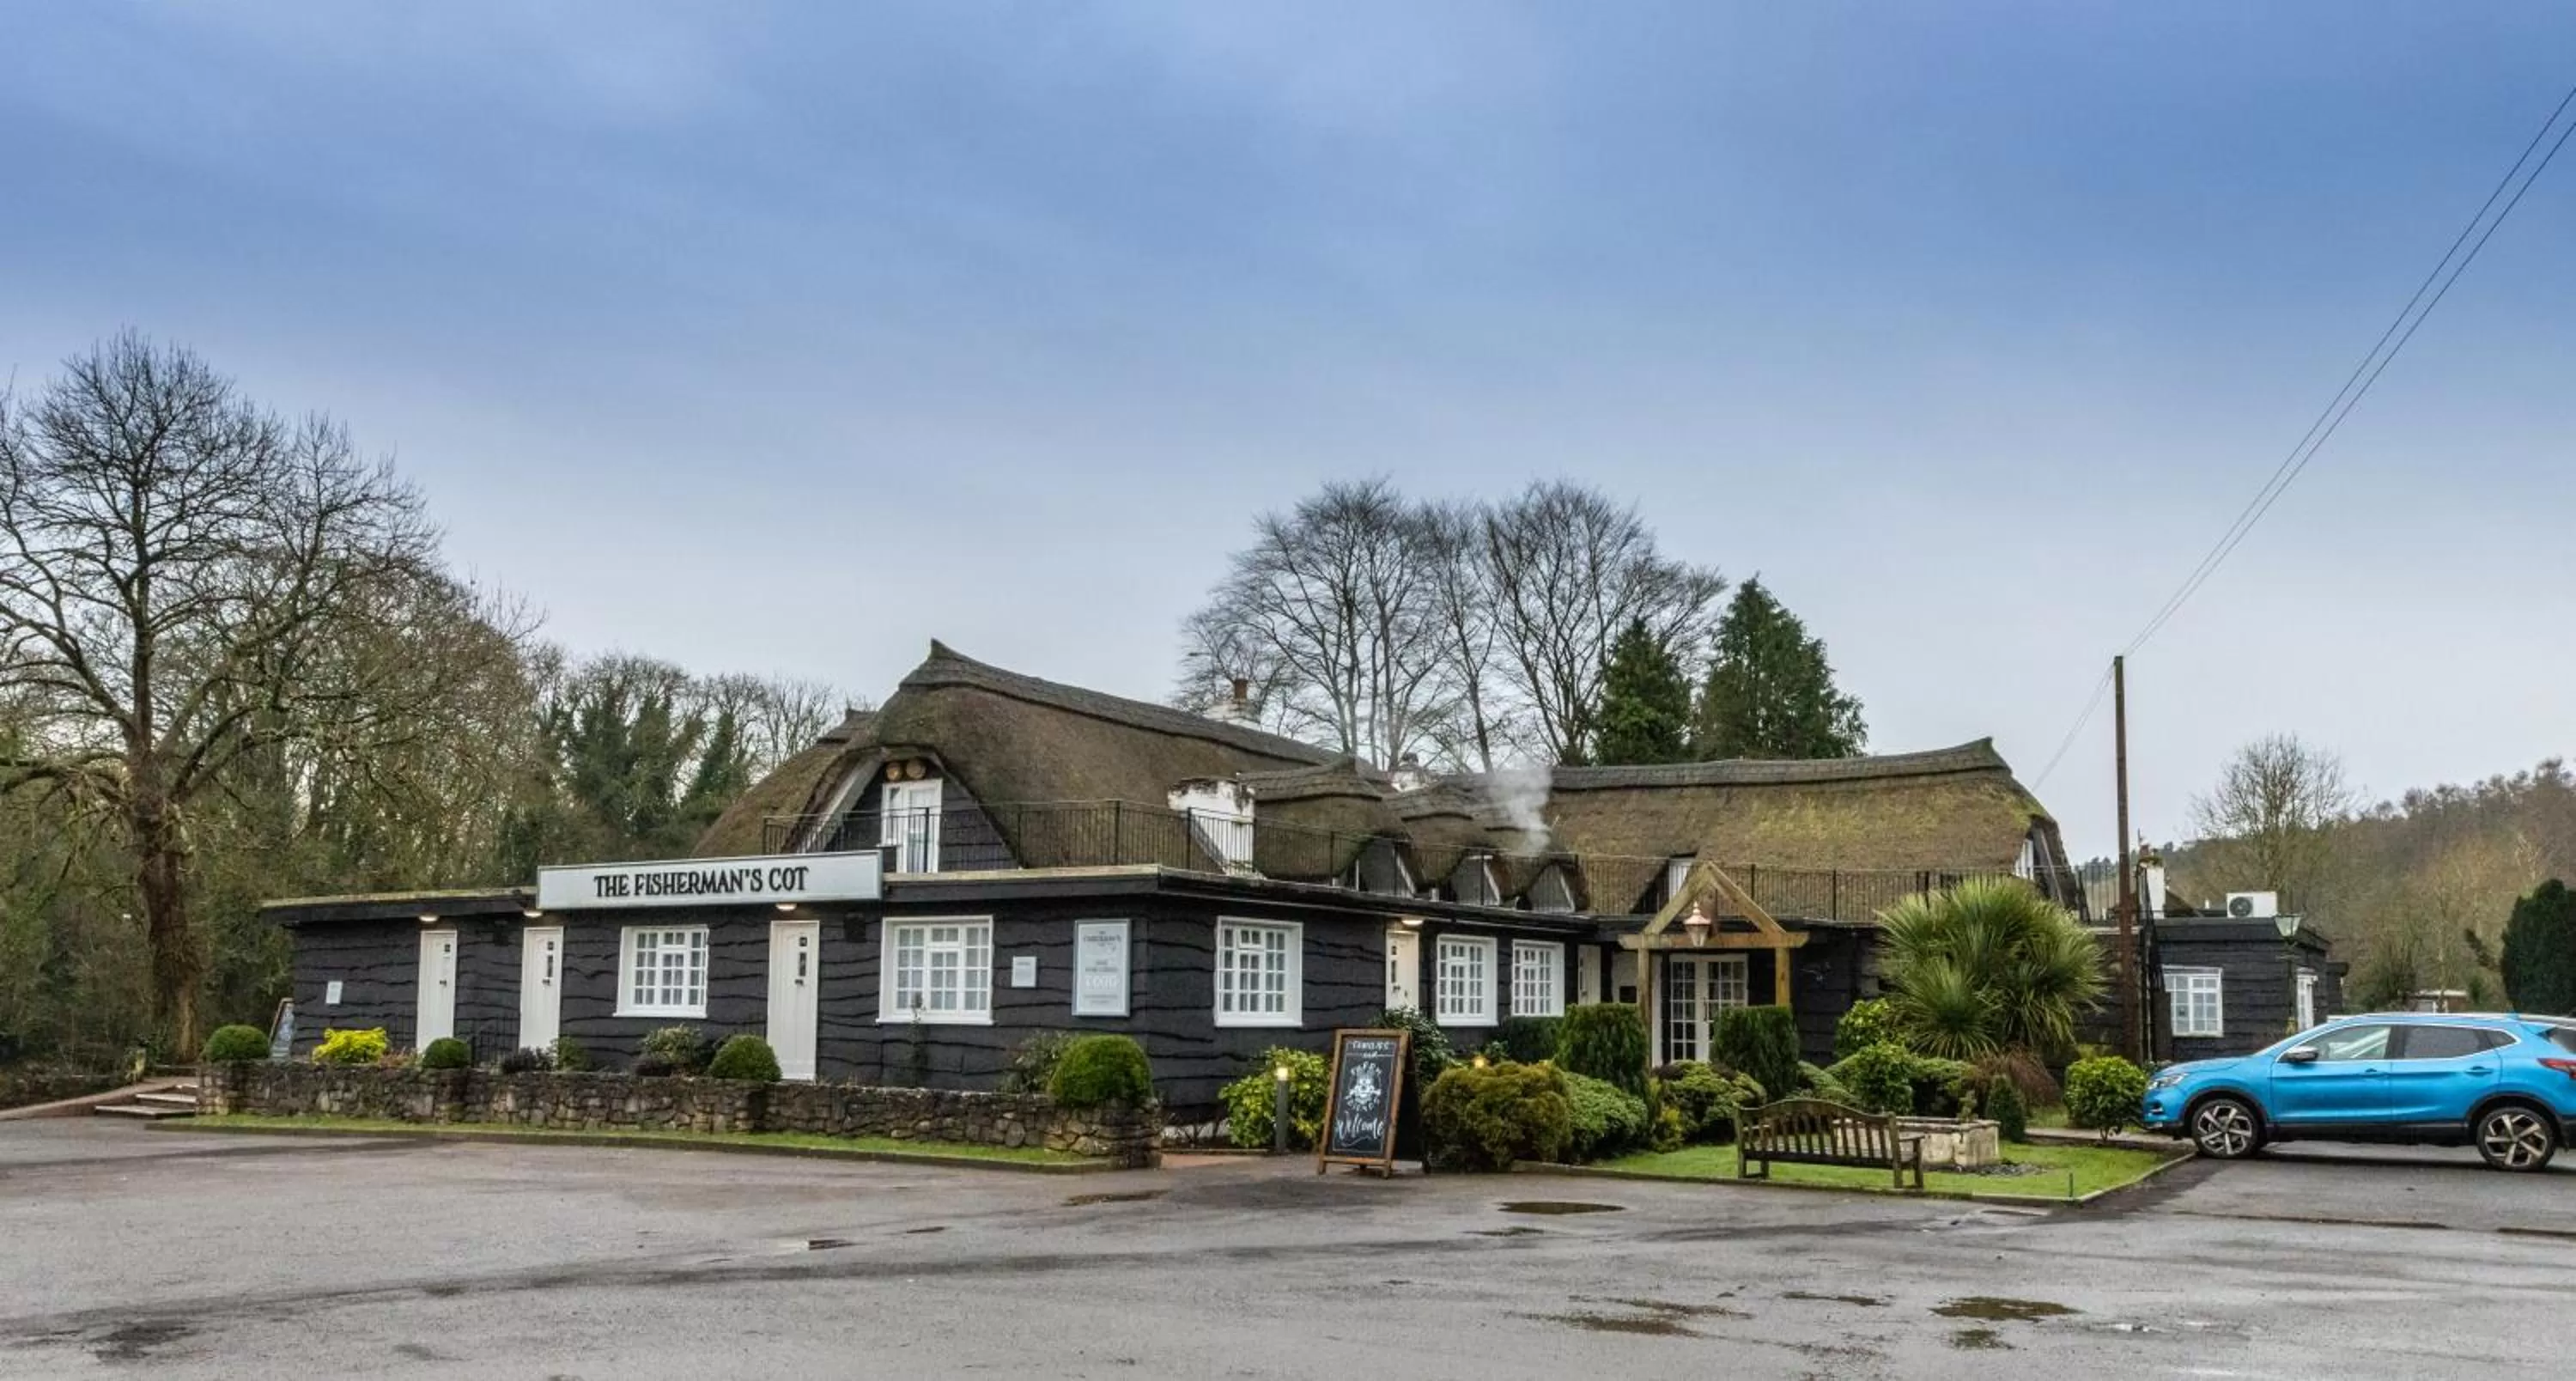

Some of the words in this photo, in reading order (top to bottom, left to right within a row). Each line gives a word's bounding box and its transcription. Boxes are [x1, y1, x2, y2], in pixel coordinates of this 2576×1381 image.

[593, 873, 629, 897] THE
[634, 868, 763, 897] FISHERMAN'S
[769, 867, 809, 892] COT
